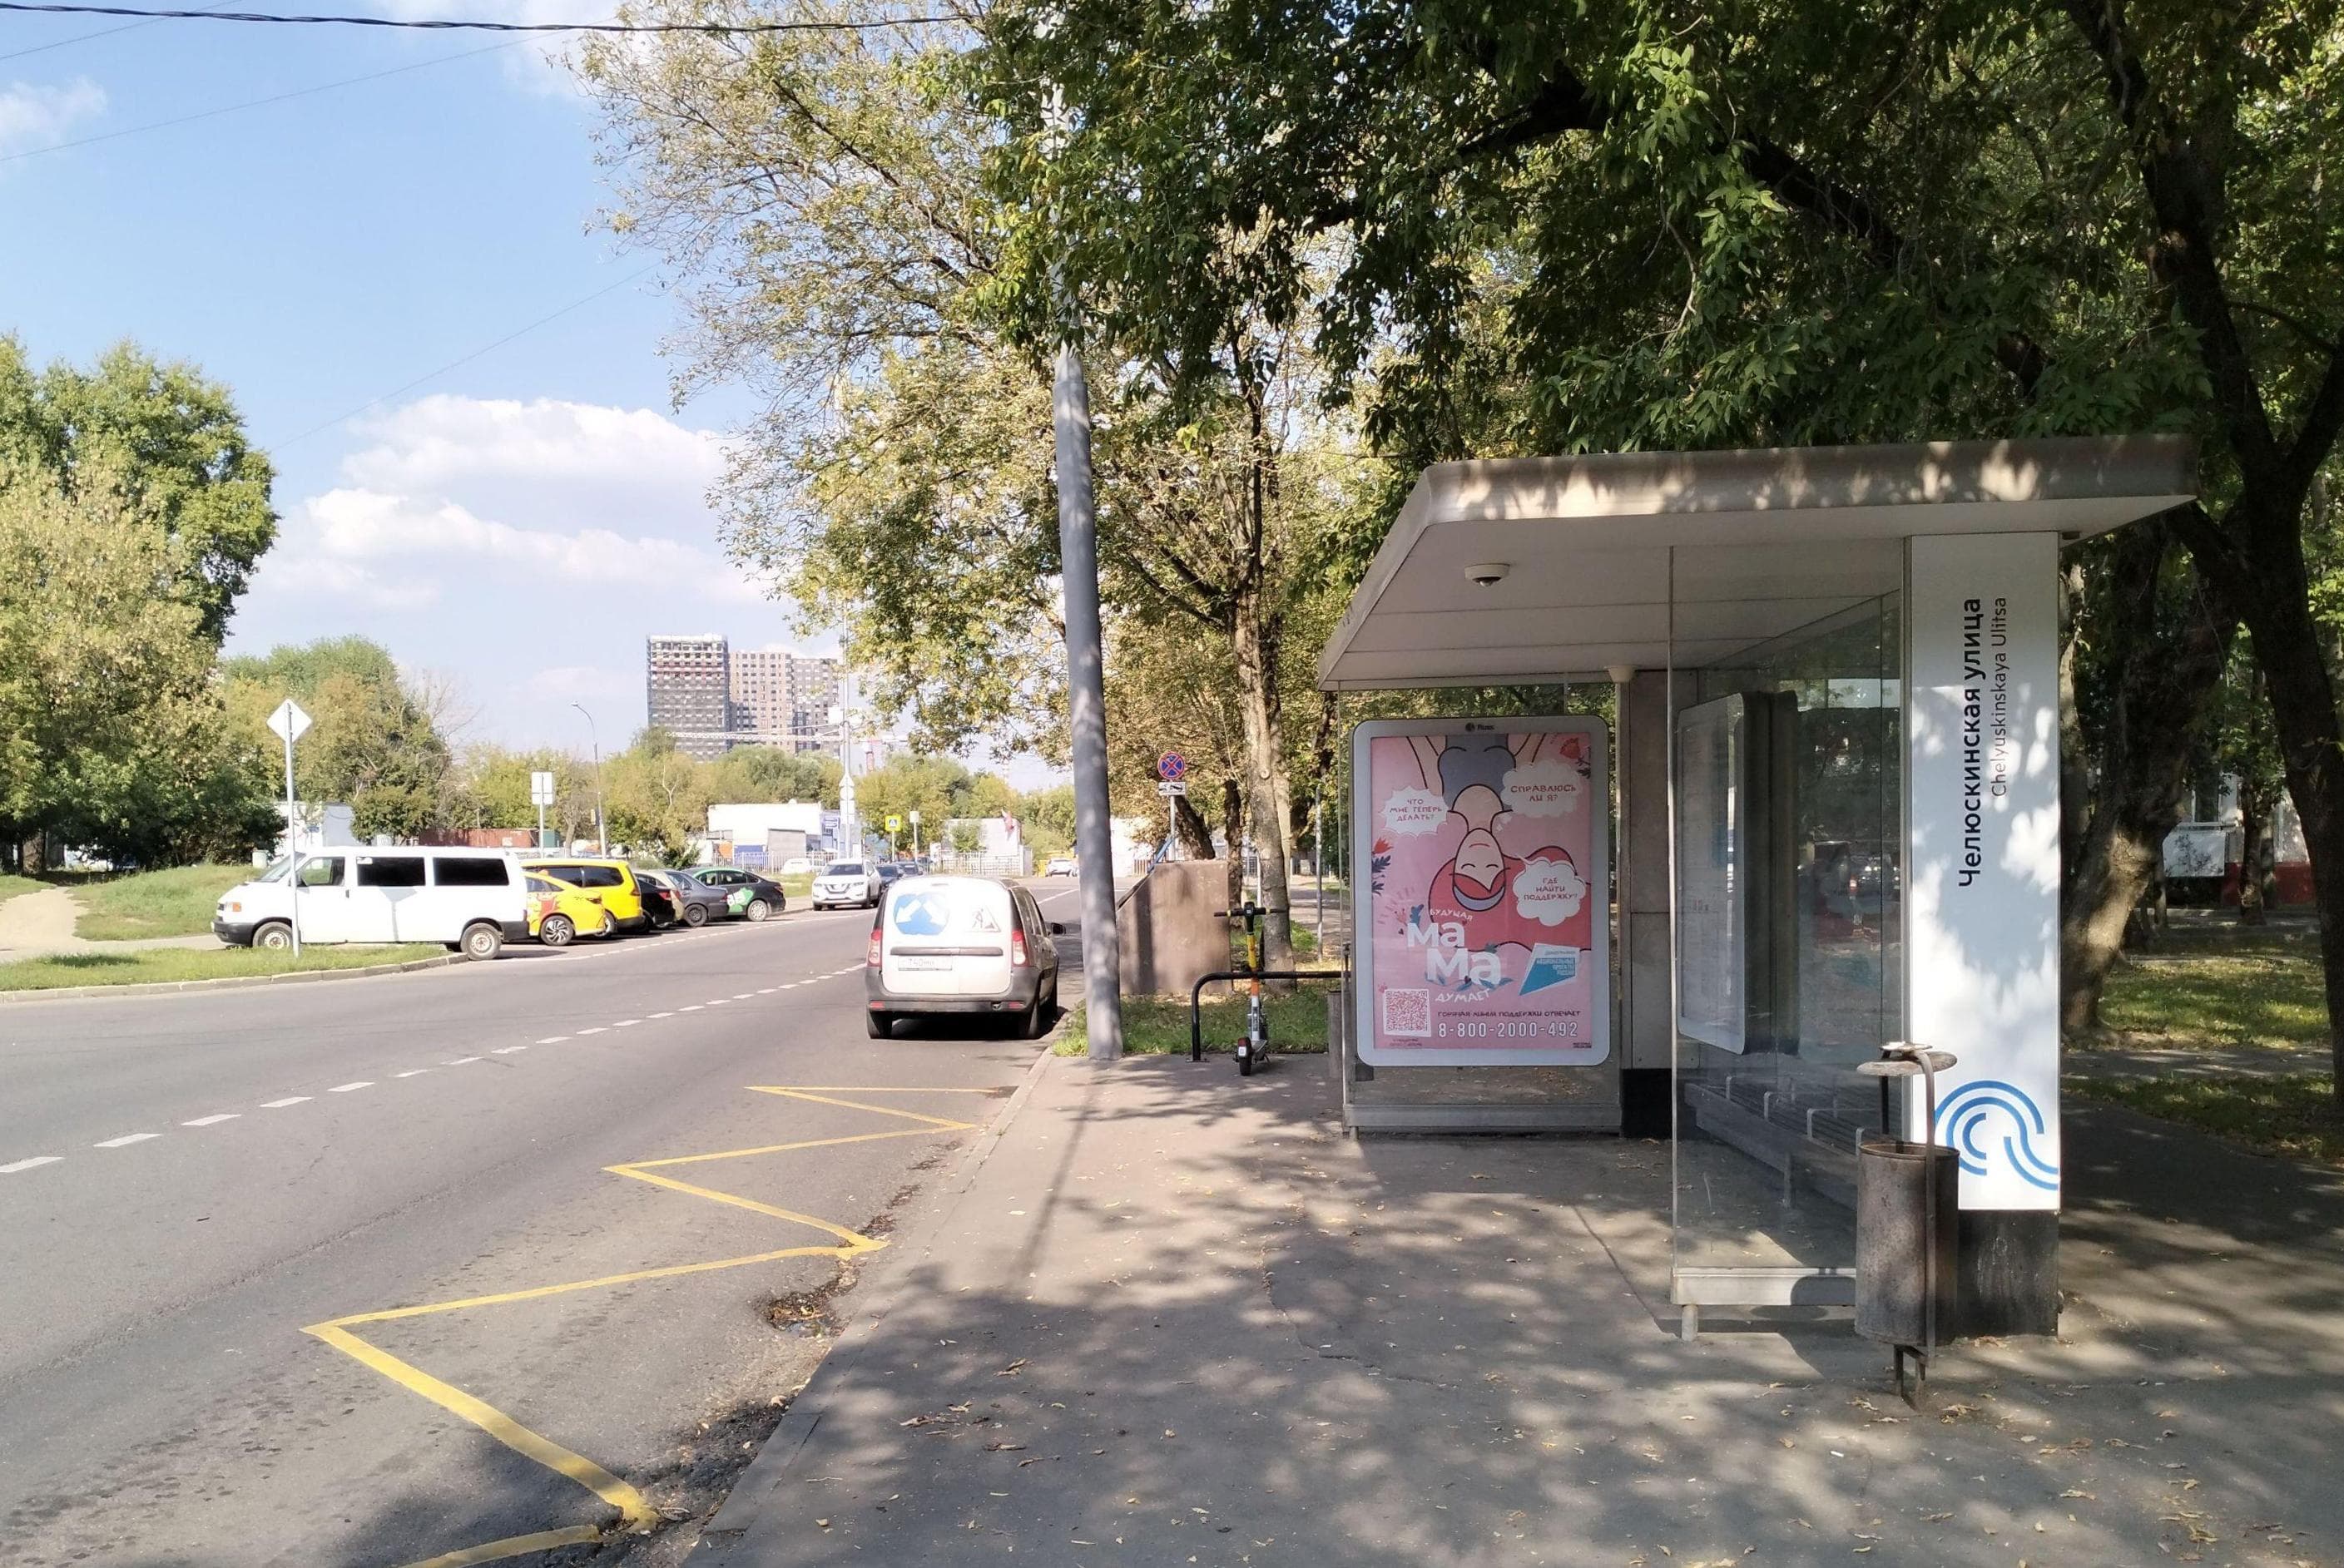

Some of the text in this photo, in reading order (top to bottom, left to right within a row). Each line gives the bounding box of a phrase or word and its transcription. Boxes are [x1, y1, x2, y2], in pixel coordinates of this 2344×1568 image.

[1958, 598, 1986, 887] Челюскинская улица
[1990, 597, 2009, 797] Chelyuskinskaya Ulitsa
[1435, 987, 1490, 1003] ДУМАЕТ
[1438, 1021, 1578, 1038] 8-800-2000-492
